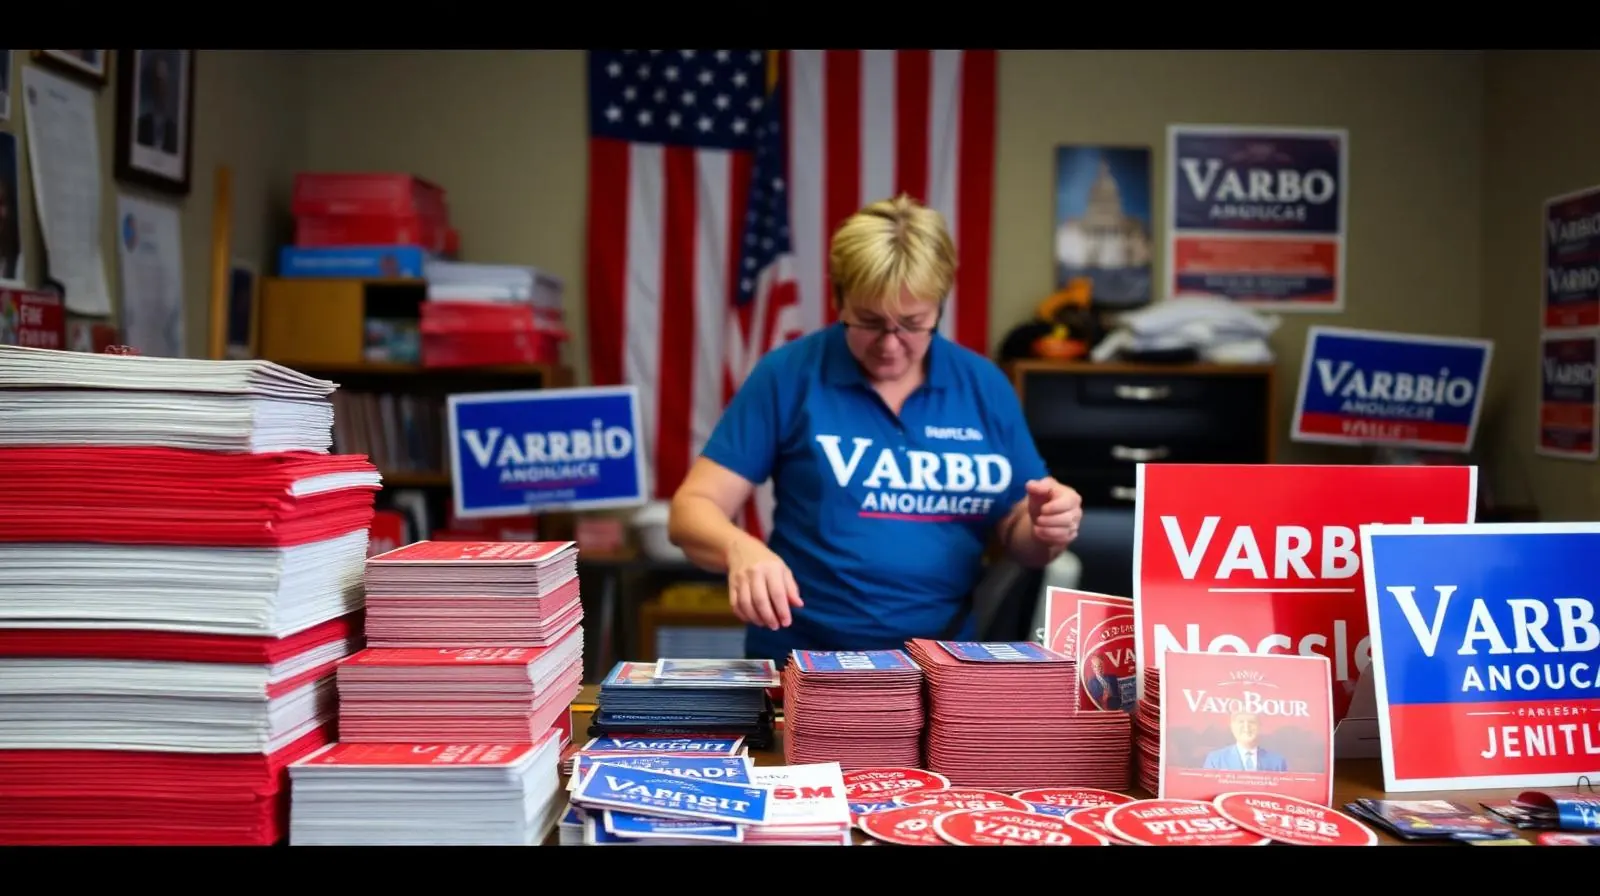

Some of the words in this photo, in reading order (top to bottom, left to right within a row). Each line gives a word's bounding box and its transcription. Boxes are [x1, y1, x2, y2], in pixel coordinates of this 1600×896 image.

[1179, 157, 1335, 204] VARBO
[815, 434, 1013, 493] VARBD
[1160, 515, 1425, 580] VARB
[1461, 662, 1600, 692] ANOUC
[1480, 723, 1600, 759] JENITL
